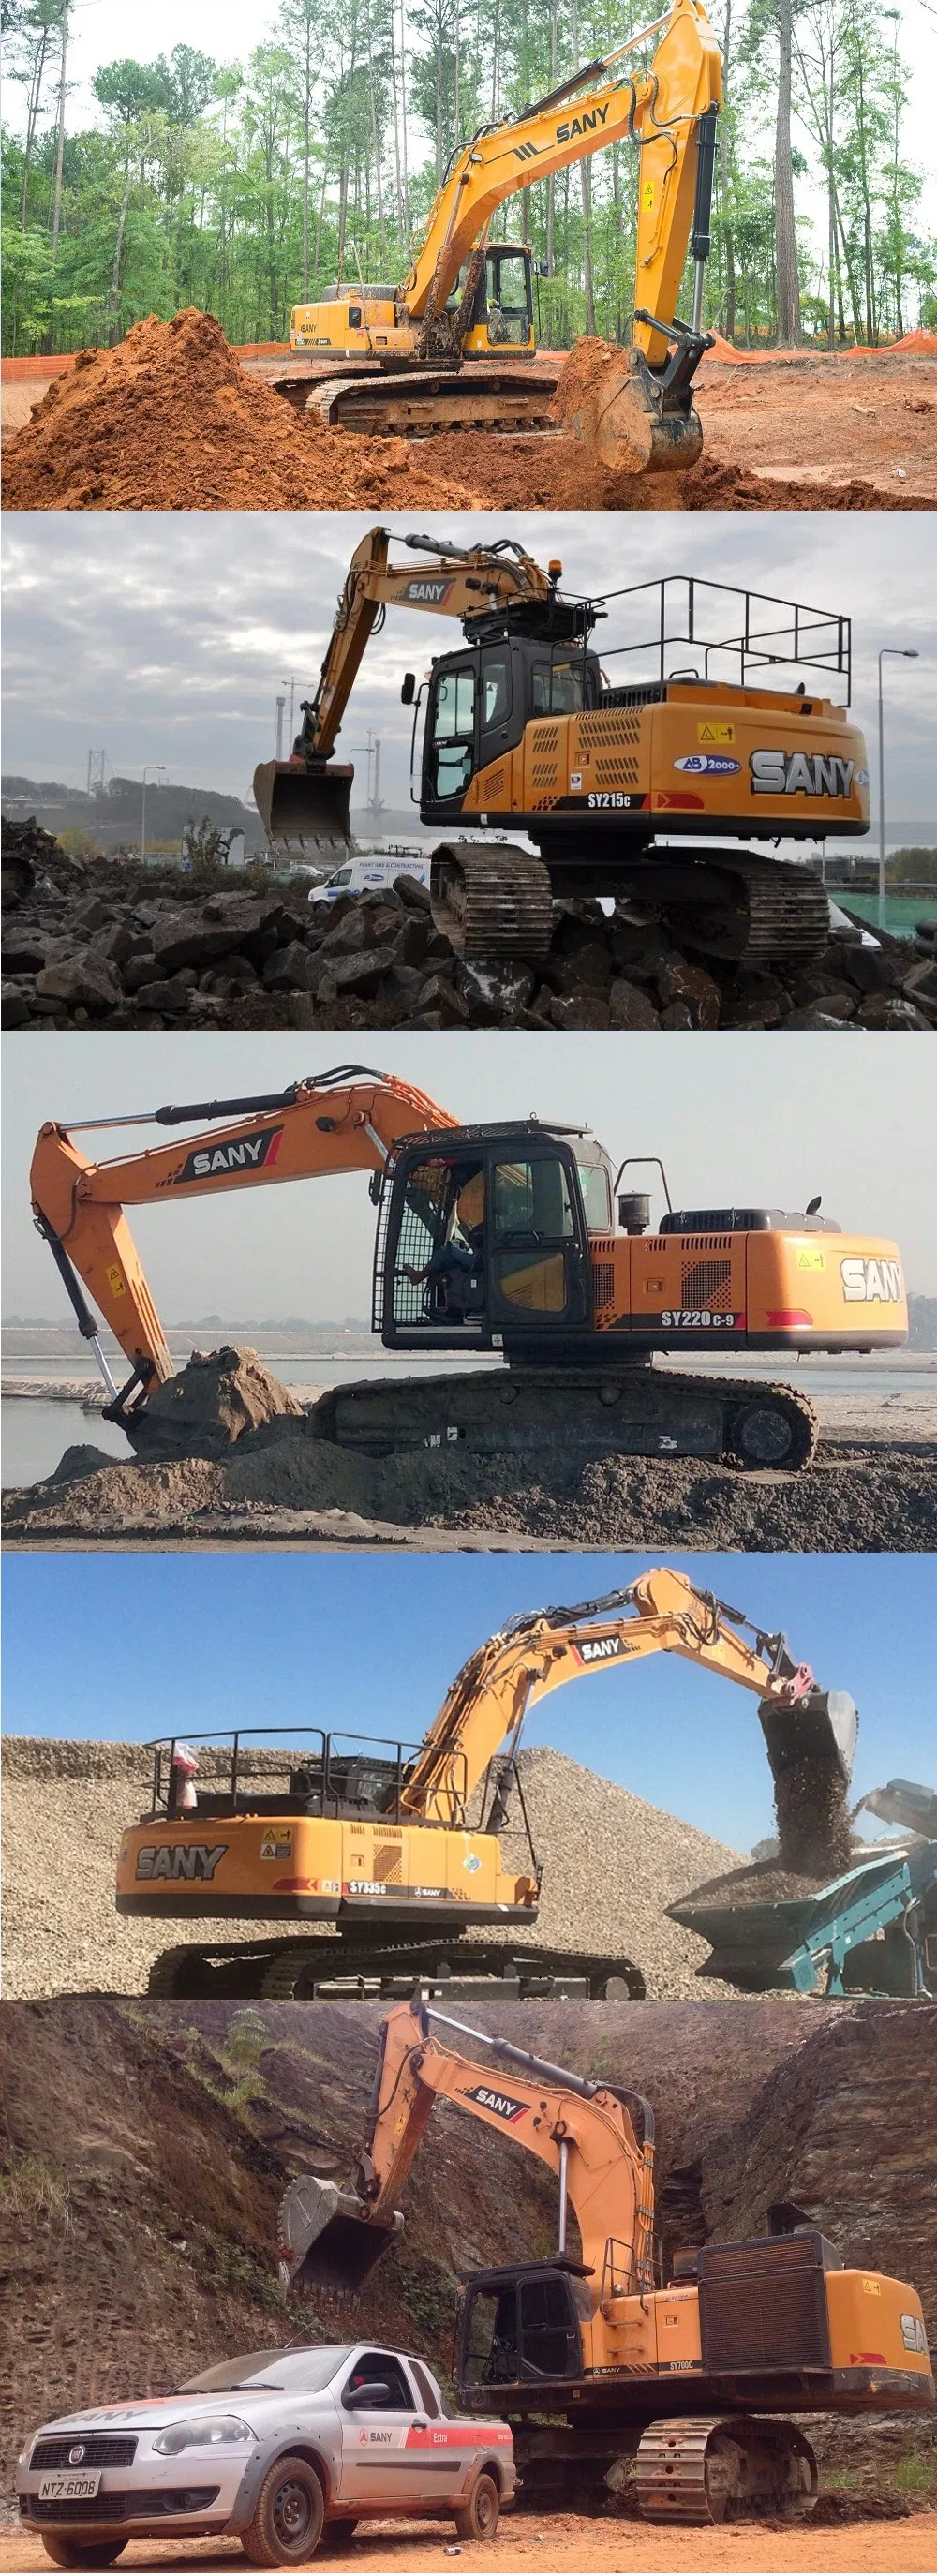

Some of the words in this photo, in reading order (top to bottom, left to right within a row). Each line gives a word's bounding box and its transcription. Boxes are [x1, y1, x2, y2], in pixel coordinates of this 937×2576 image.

[556, 102, 610, 145] SANY
[409, 583, 445, 600] SANY
[682, 757, 702, 769] AB
[708, 759, 735, 769] 2000
[749, 749, 855, 799] SANY
[193, 1139, 263, 1175] SANY
[661, 1310, 711, 1327] SY220
[581, 1638, 620, 1660] SANY
[135, 1845, 229, 1881] SANY
[422, 1888, 441, 1897] SANY
[475, 2089, 517, 2116] SANY
[669, 2360, 693, 2371] SY700C
[370, 2433, 393, 2443] SANY
[433, 2433, 448, 2444] Extra
